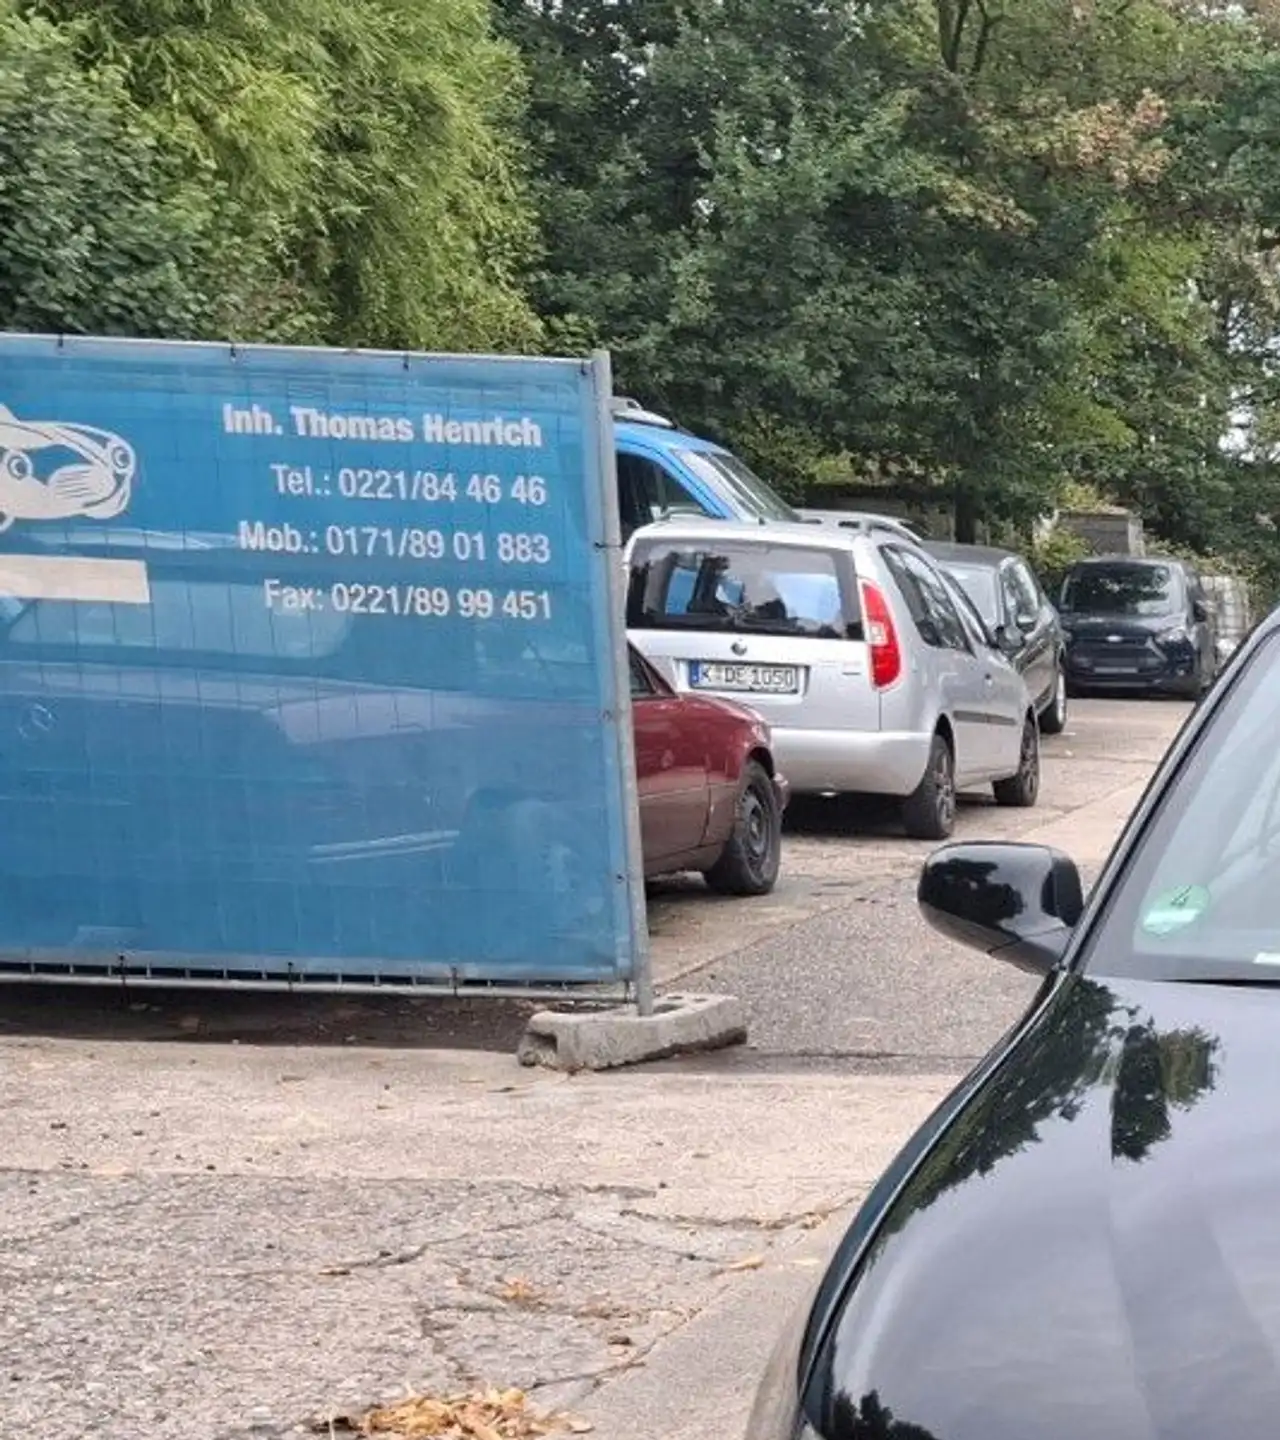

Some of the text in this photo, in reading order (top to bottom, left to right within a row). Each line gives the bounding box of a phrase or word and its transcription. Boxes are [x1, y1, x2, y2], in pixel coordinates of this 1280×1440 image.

[223, 403, 542, 448] Inh. Thomas Henrich
[270, 463, 547, 506] Tel.: 0221/84 46 46
[238, 520, 550, 564] Mob.: 0171/89 01 883
[263, 578, 551, 620] Fax: 0221/89 99 451
